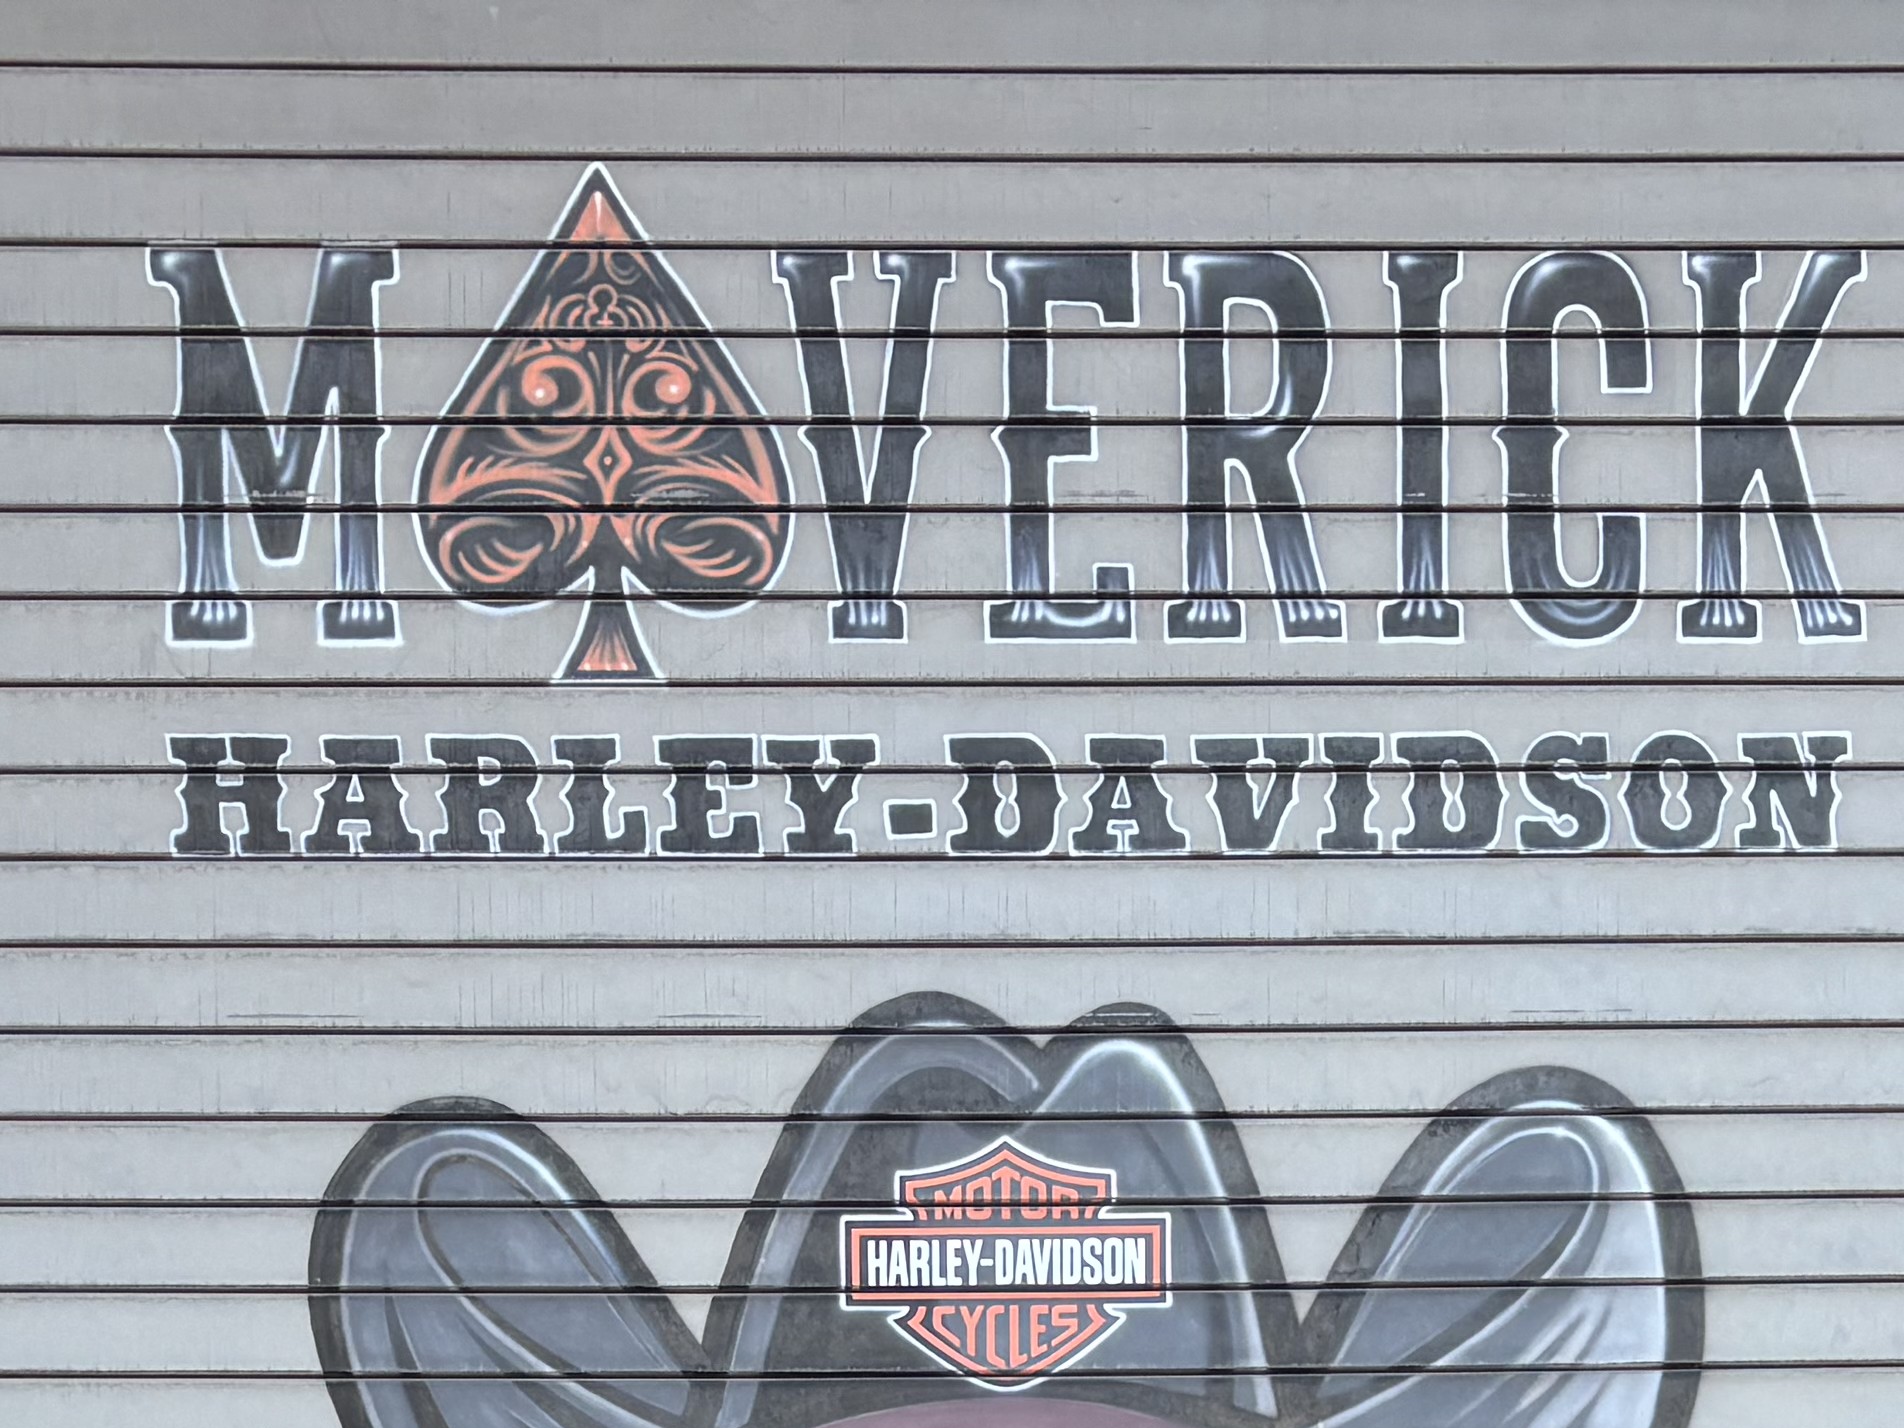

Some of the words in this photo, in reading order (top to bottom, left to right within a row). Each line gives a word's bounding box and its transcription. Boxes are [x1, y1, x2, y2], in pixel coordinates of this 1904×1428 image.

[165, 732, 1852, 857] HARLEY-DAVIDSON
[934, 1166, 1080, 1221] MOTOR
[866, 1237, 1147, 1288] HARLEY-DAVIDSON
[932, 1304, 1079, 1369] CYCLES
